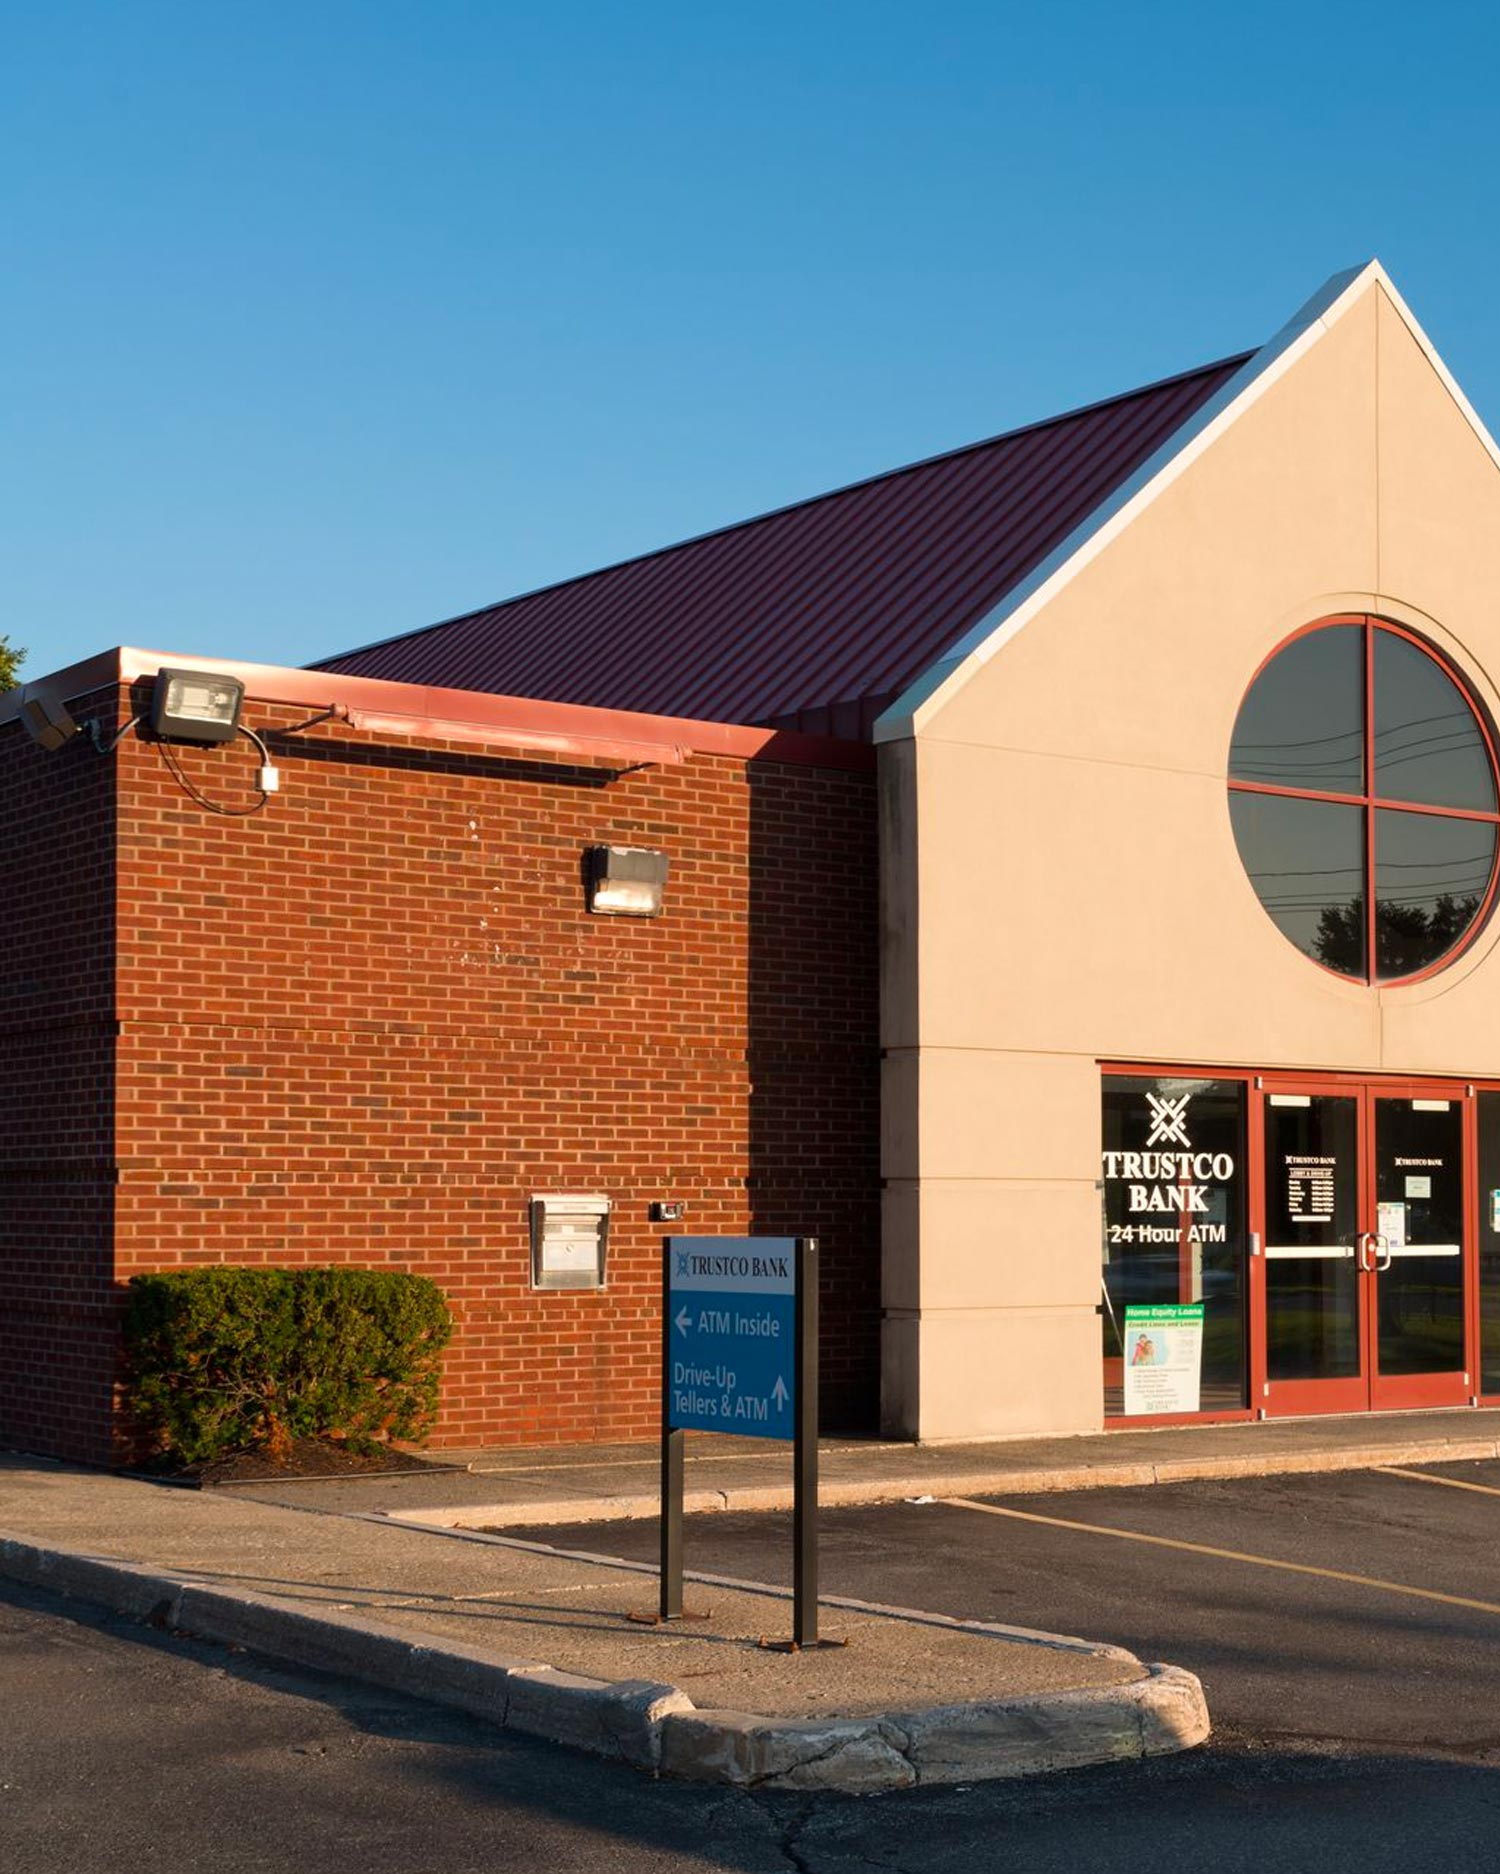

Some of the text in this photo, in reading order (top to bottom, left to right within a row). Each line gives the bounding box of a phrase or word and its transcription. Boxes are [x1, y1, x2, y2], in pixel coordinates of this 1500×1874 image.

[1102, 1151, 1234, 1180] TRUSTCO
[1129, 1185, 1209, 1212] BANK
[1111, 1225, 1226, 1243] 24 Hour ATM
[691, 1255, 788, 1278] TRUSTCO BANK
[698, 1311, 780, 1337] ATM Inside
[674, 1362, 736, 1393] Drive-Up
[674, 1390, 768, 1421] Tellers & ATM
